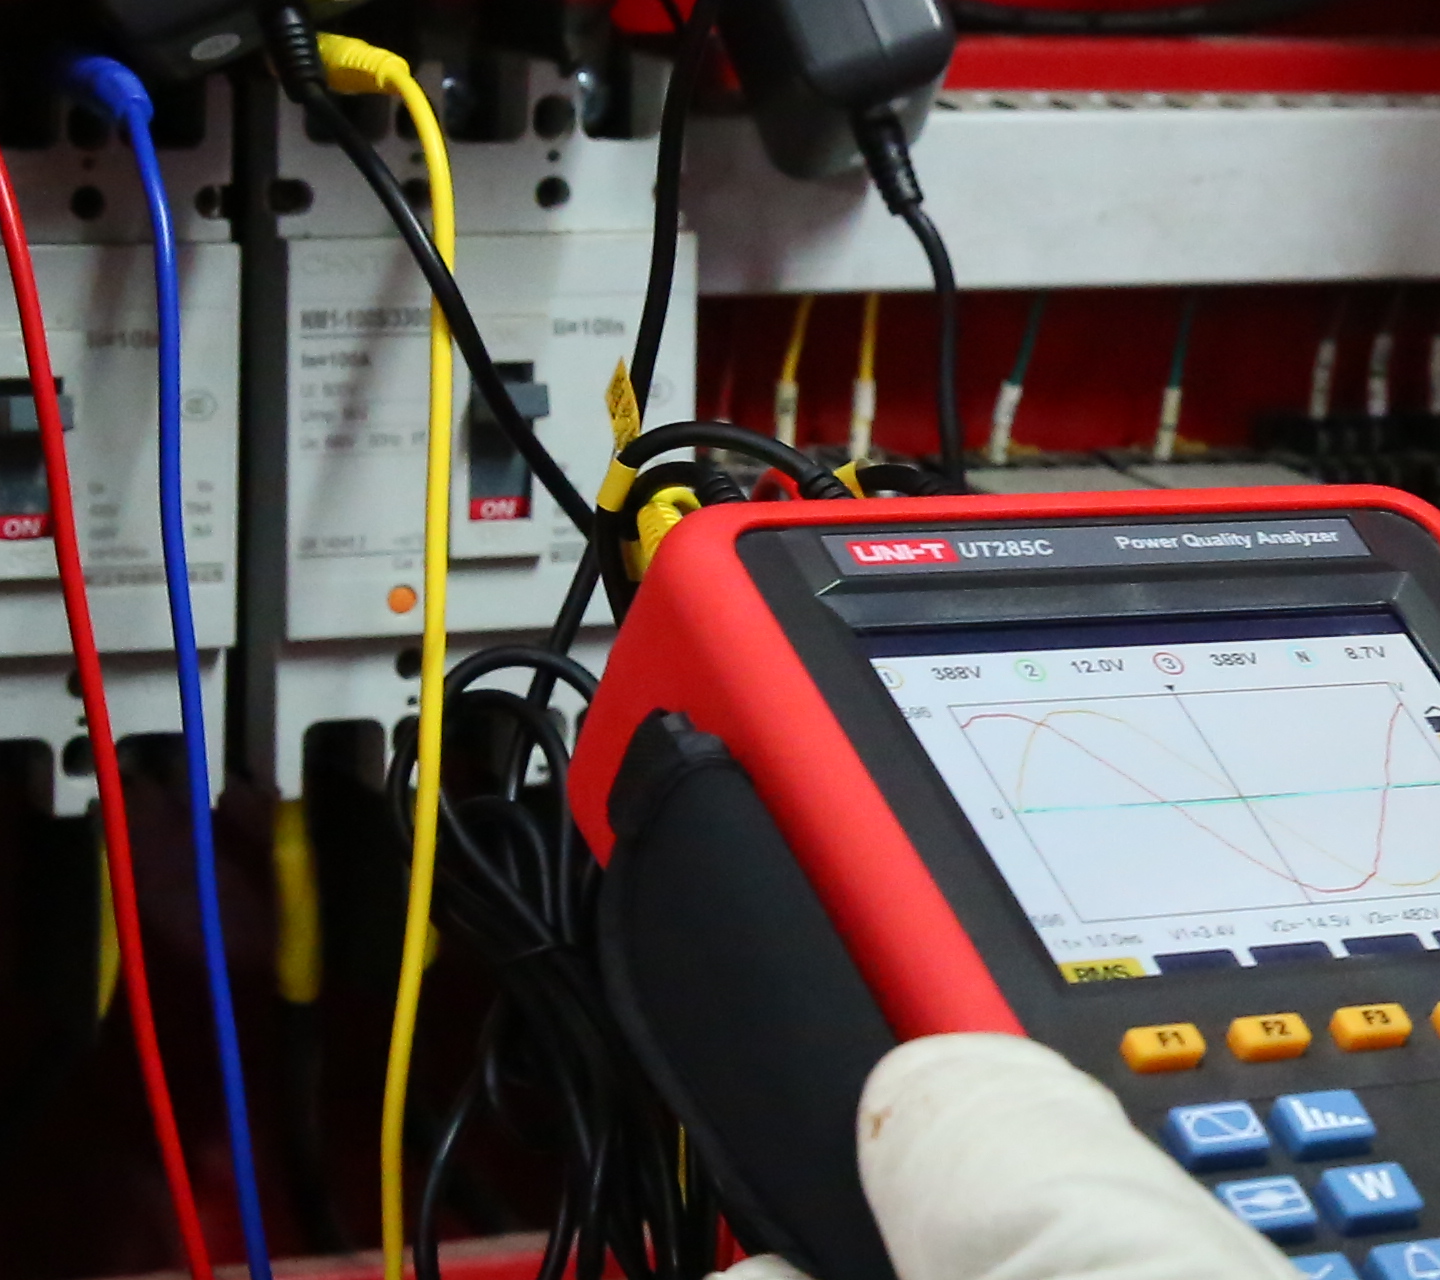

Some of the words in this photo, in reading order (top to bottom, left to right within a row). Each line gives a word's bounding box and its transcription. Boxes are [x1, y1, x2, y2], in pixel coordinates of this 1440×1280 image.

[479, 500, 516, 520] ON
[2, 518, 42, 538] ON
[852, 543, 945, 562] UNI-T
[958, 539, 1054, 558] UT285C
[1113, 535, 1179, 551] Power
[1182, 531, 1252, 549] Quality
[1256, 529, 1339, 547] Analyzer
[930, 665, 982, 681] 388V
[1069, 658, 1126, 675] 12.0V
[1209, 651, 1258, 667] 388V
[1343, 645, 1386, 661] 8.7V
[1154, 1031, 1187, 1047] F1
[1260, 1020, 1292, 1037] F2
[1360, 1009, 1392, 1026] F3
[1346, 1169, 1397, 1201] W
